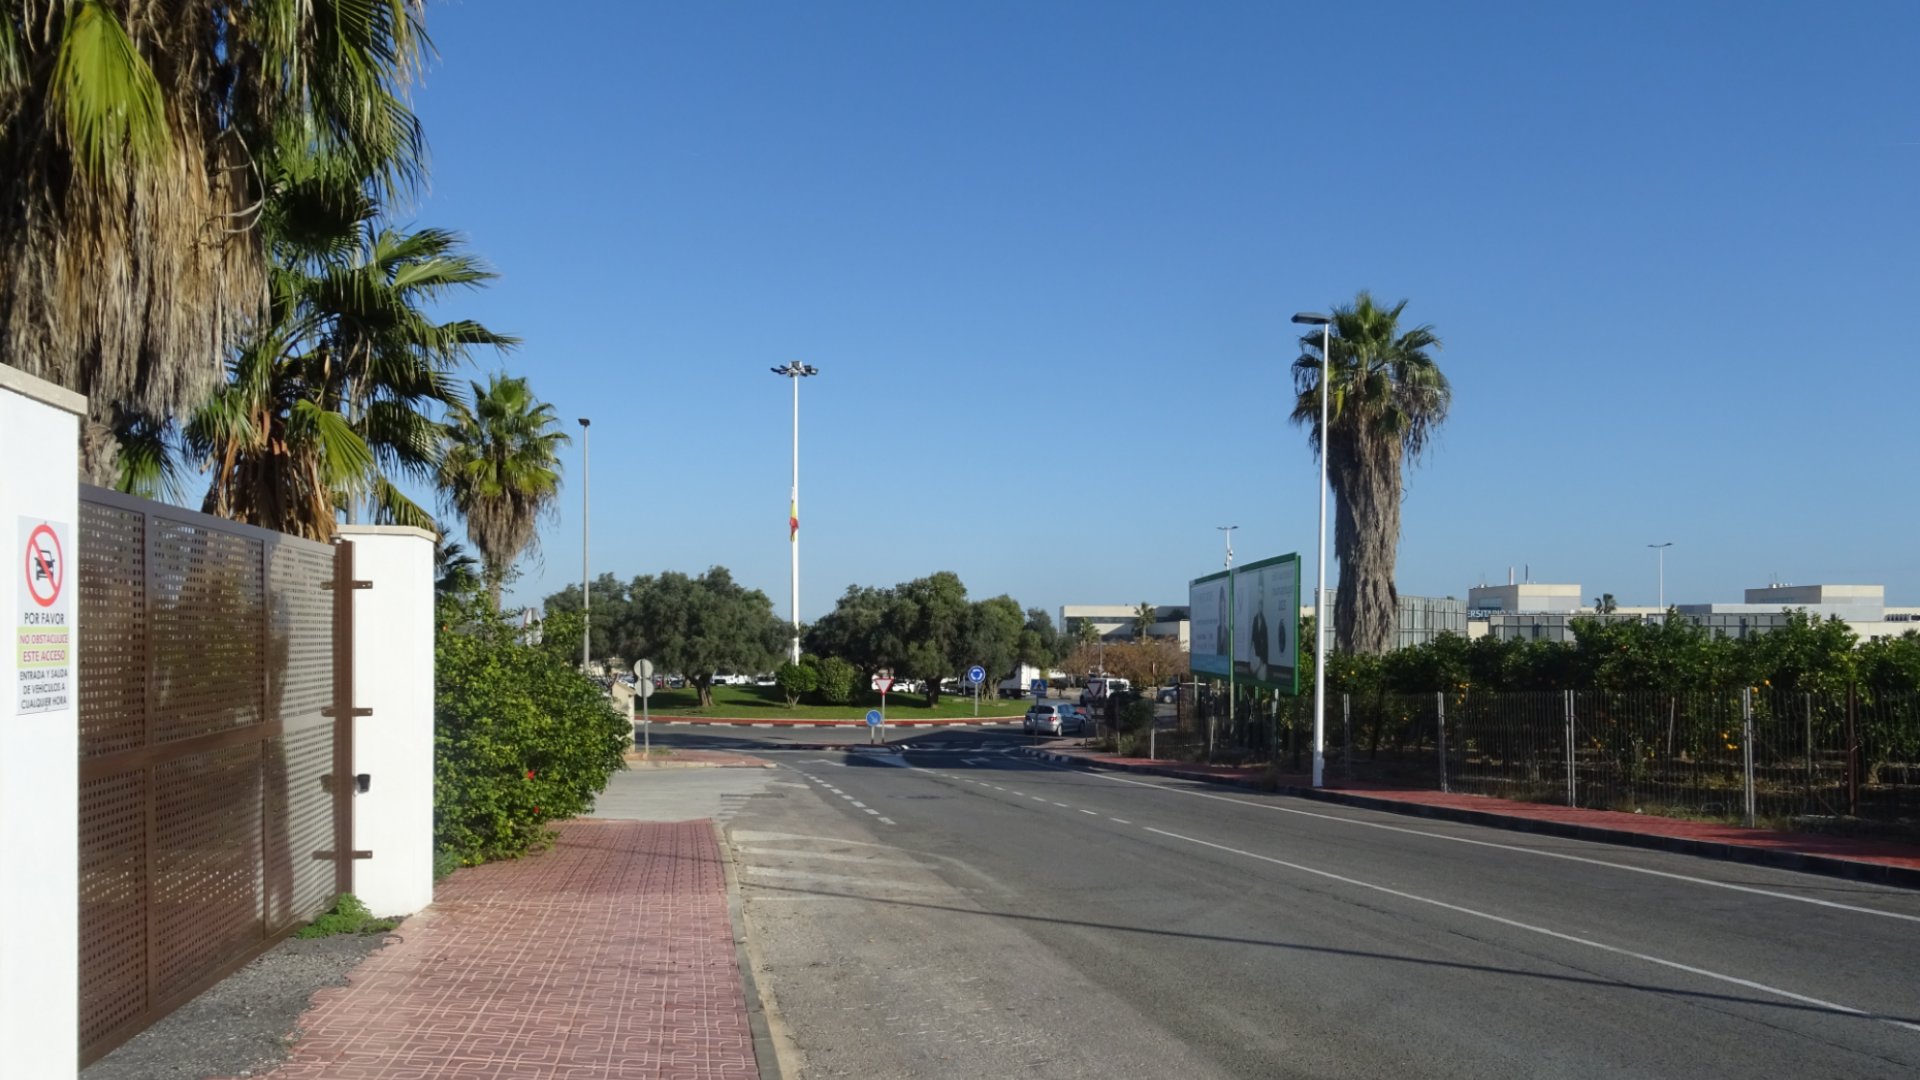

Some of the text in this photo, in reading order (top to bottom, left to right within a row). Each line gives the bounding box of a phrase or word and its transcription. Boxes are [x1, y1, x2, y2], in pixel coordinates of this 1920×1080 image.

[24, 612, 65, 624] POR FAVOR
[20, 634, 30, 644] NO
[23, 650, 65, 662] ESTE ACCESO
[20, 668, 68, 681] ENTRADA Y SALIDA
[23, 685, 31, 695] DE
[61, 682, 65, 690] A
[21, 695, 67, 709] CUALQUIER HORA
